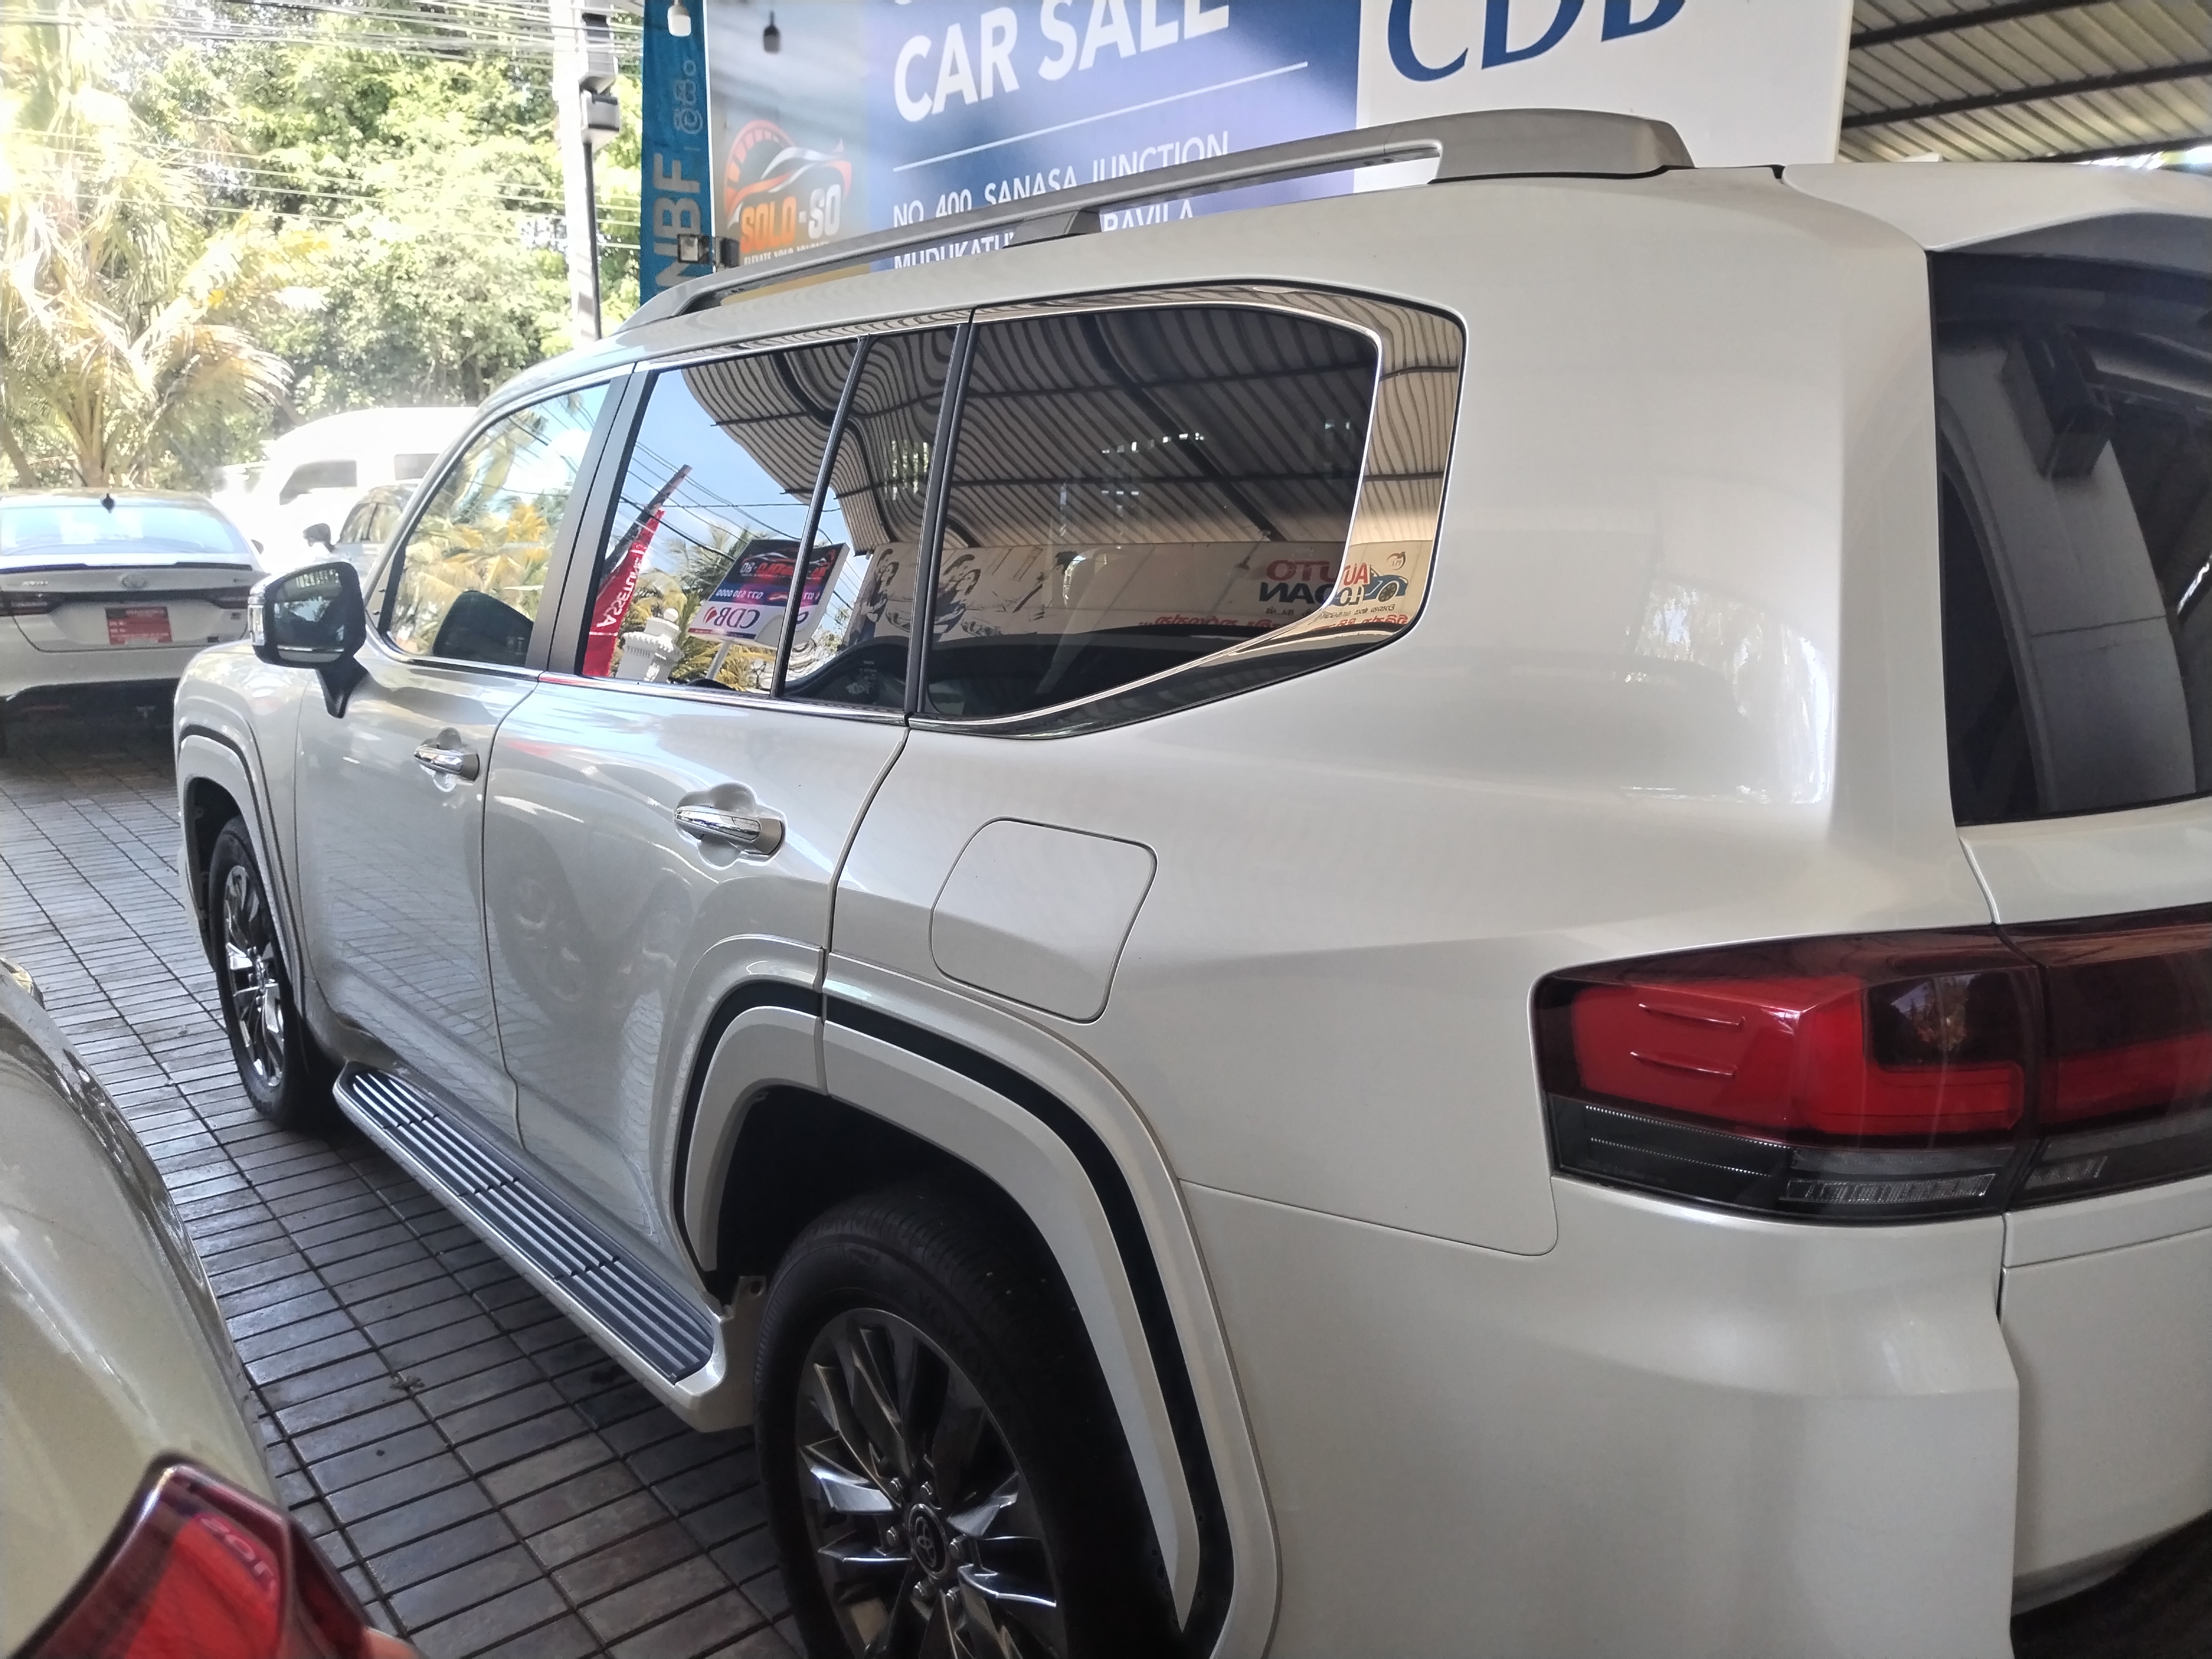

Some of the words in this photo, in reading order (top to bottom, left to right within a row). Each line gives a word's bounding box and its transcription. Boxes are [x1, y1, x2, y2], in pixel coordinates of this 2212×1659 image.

[894, 7, 1020, 122] CAR
[893, 199, 925, 228] NO
[935, 188, 973, 218] 400
[984, 165, 1078, 204] SANASA
[1093, 131, 1228, 182] JUNCTION
[894, 231, 1015, 269] MUDUKATU
